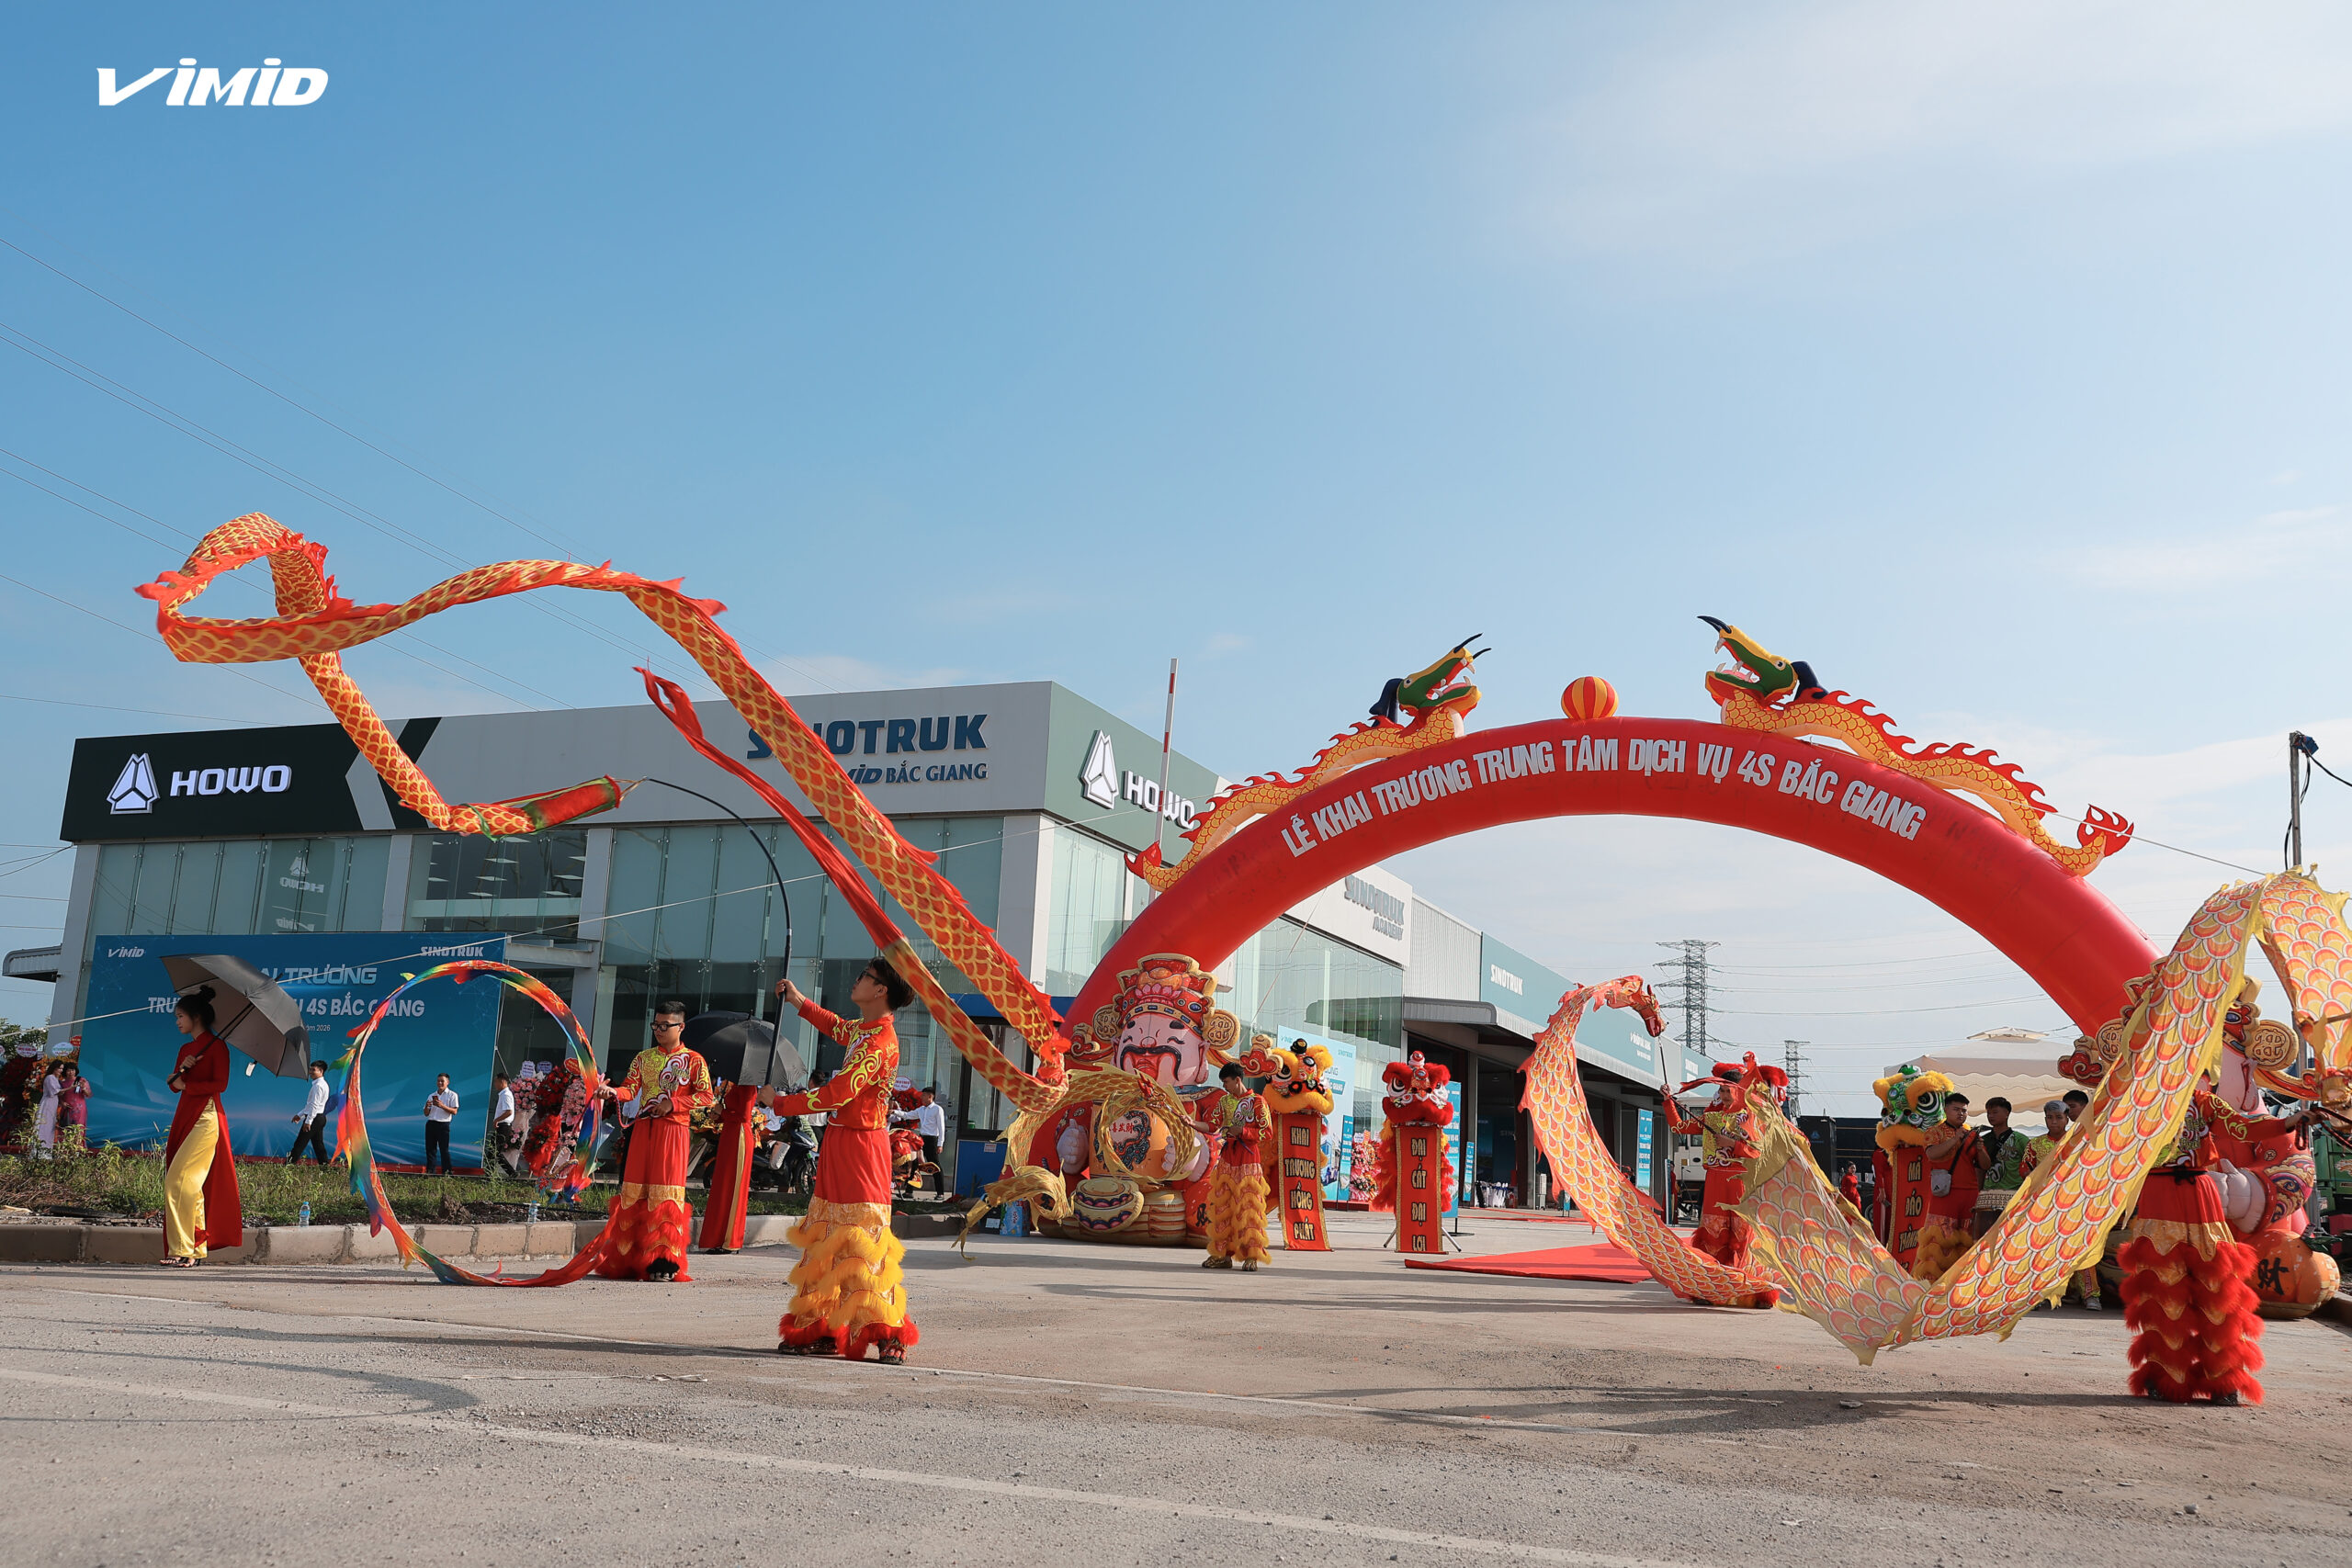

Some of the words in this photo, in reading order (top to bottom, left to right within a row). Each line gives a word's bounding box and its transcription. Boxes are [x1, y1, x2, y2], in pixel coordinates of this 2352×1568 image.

[169, 764, 292, 797] HOWO
[885, 761, 922, 784] BẮC
[925, 762, 989, 784] GIANG
[1120, 770, 1195, 829] HOWO
[1280, 812, 1318, 858] LỄ
[1310, 791, 1374, 842] KHAI
[1370, 759, 1473, 817] TRƯƠNG
[1472, 740, 1556, 785] TRUNG
[1561, 734, 1619, 772] TÂM
[1627, 738, 1687, 777] DỊCH
[1696, 742, 1734, 784] VỤ
[1736, 750, 1776, 787] 4S
[1777, 758, 1839, 805] BẮC
[1839, 780, 1928, 841] GIANG
[107, 946, 145, 958] VIMID
[420, 946, 484, 957] SINOTRUK
[284, 964, 378, 985] TRƯƠNG
[306, 998, 328, 1016] 4S
[331, 991, 365, 1016] BẮC
[1290, 1126, 1310, 1146] KHAI
[1411, 1137, 1427, 1161] ĐẠI
[1411, 1163, 1427, 1189] CÁT
[1411, 1202, 1427, 1227] ĐẠI
[1294, 1217, 1315, 1241] PHÁT
